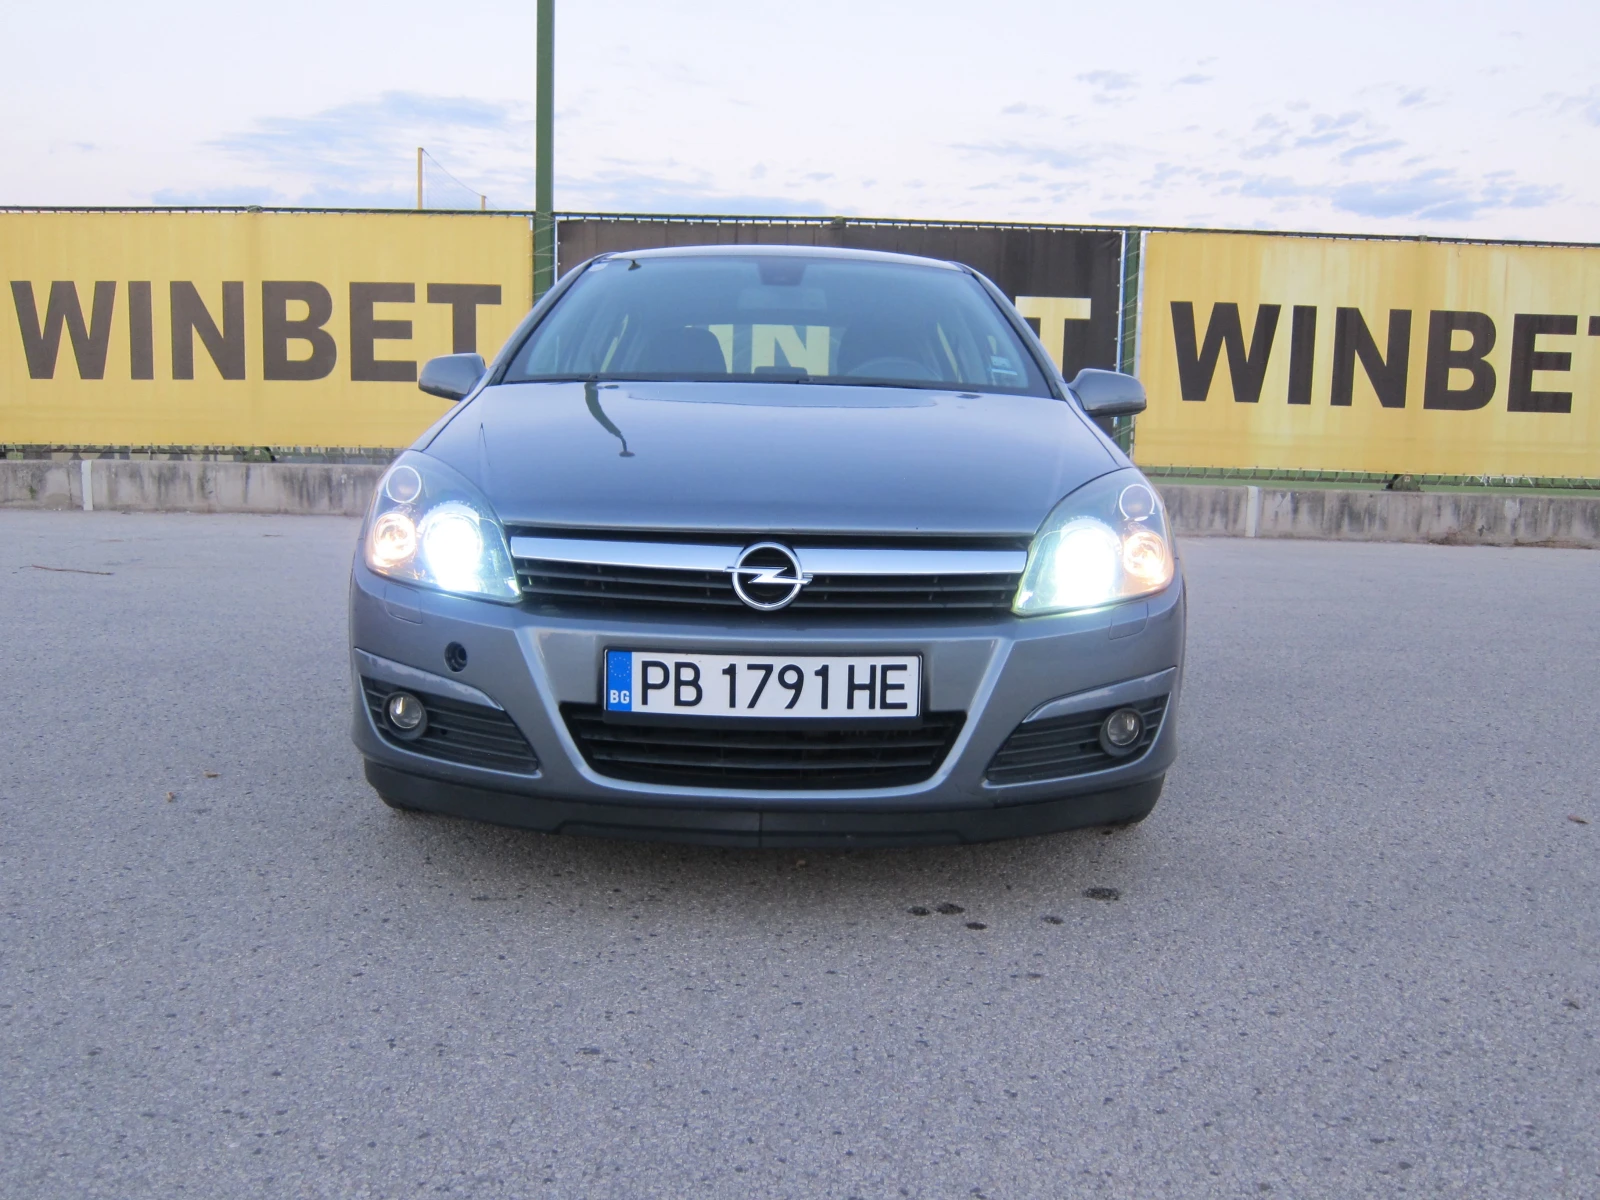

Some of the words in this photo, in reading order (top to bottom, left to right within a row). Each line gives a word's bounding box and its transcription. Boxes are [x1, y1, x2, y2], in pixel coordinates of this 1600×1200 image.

[10, 280, 502, 382] WINBET
[1170, 301, 1600, 413] WINBE
[609, 689, 630, 704] BG
[640, 660, 703, 707] PB
[721, 663, 829, 710] 1791
[846, 664, 908, 710] HE
